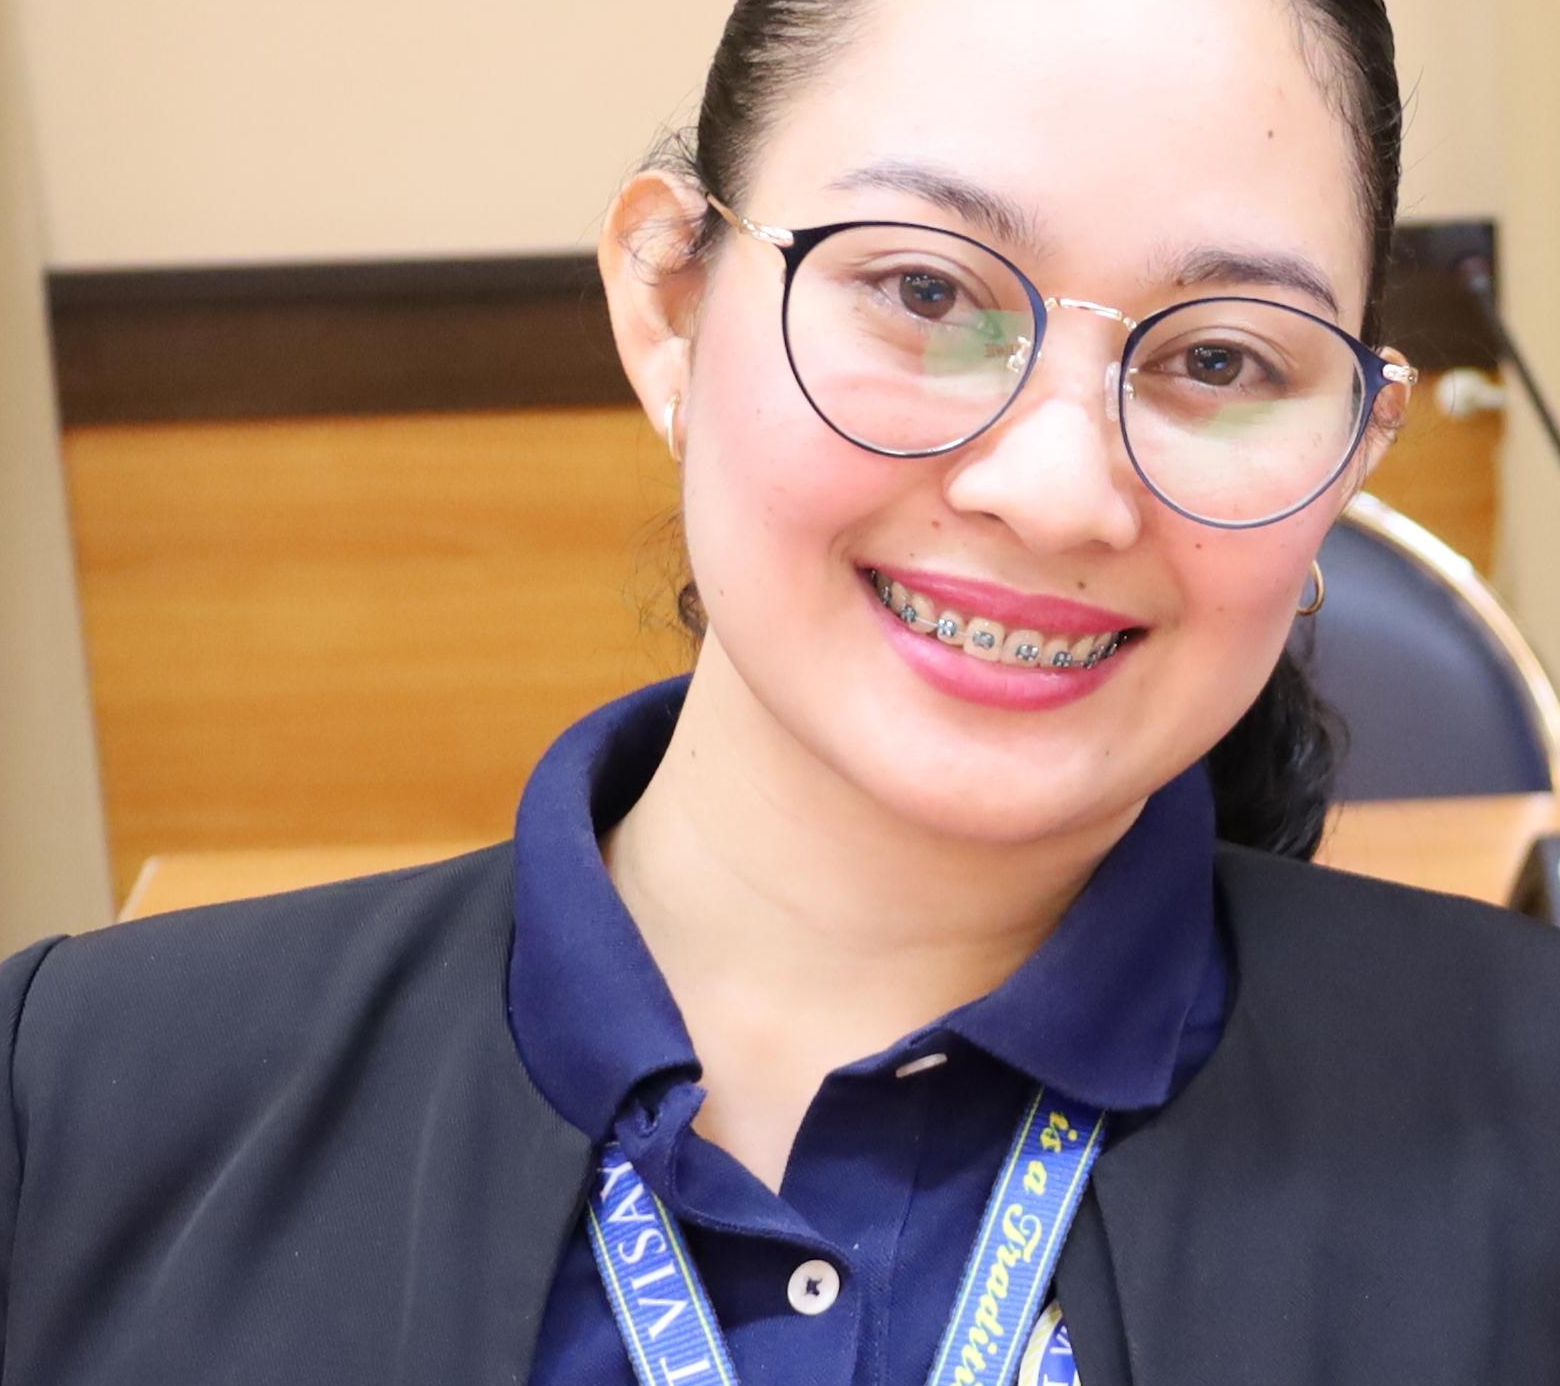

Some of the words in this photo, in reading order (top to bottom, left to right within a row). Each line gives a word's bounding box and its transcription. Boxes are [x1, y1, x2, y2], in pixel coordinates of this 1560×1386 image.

[1039, 1111, 1079, 1154] is
[1023, 1160, 1048, 1197] a
[599, 1160, 690, 1342] VISAY
